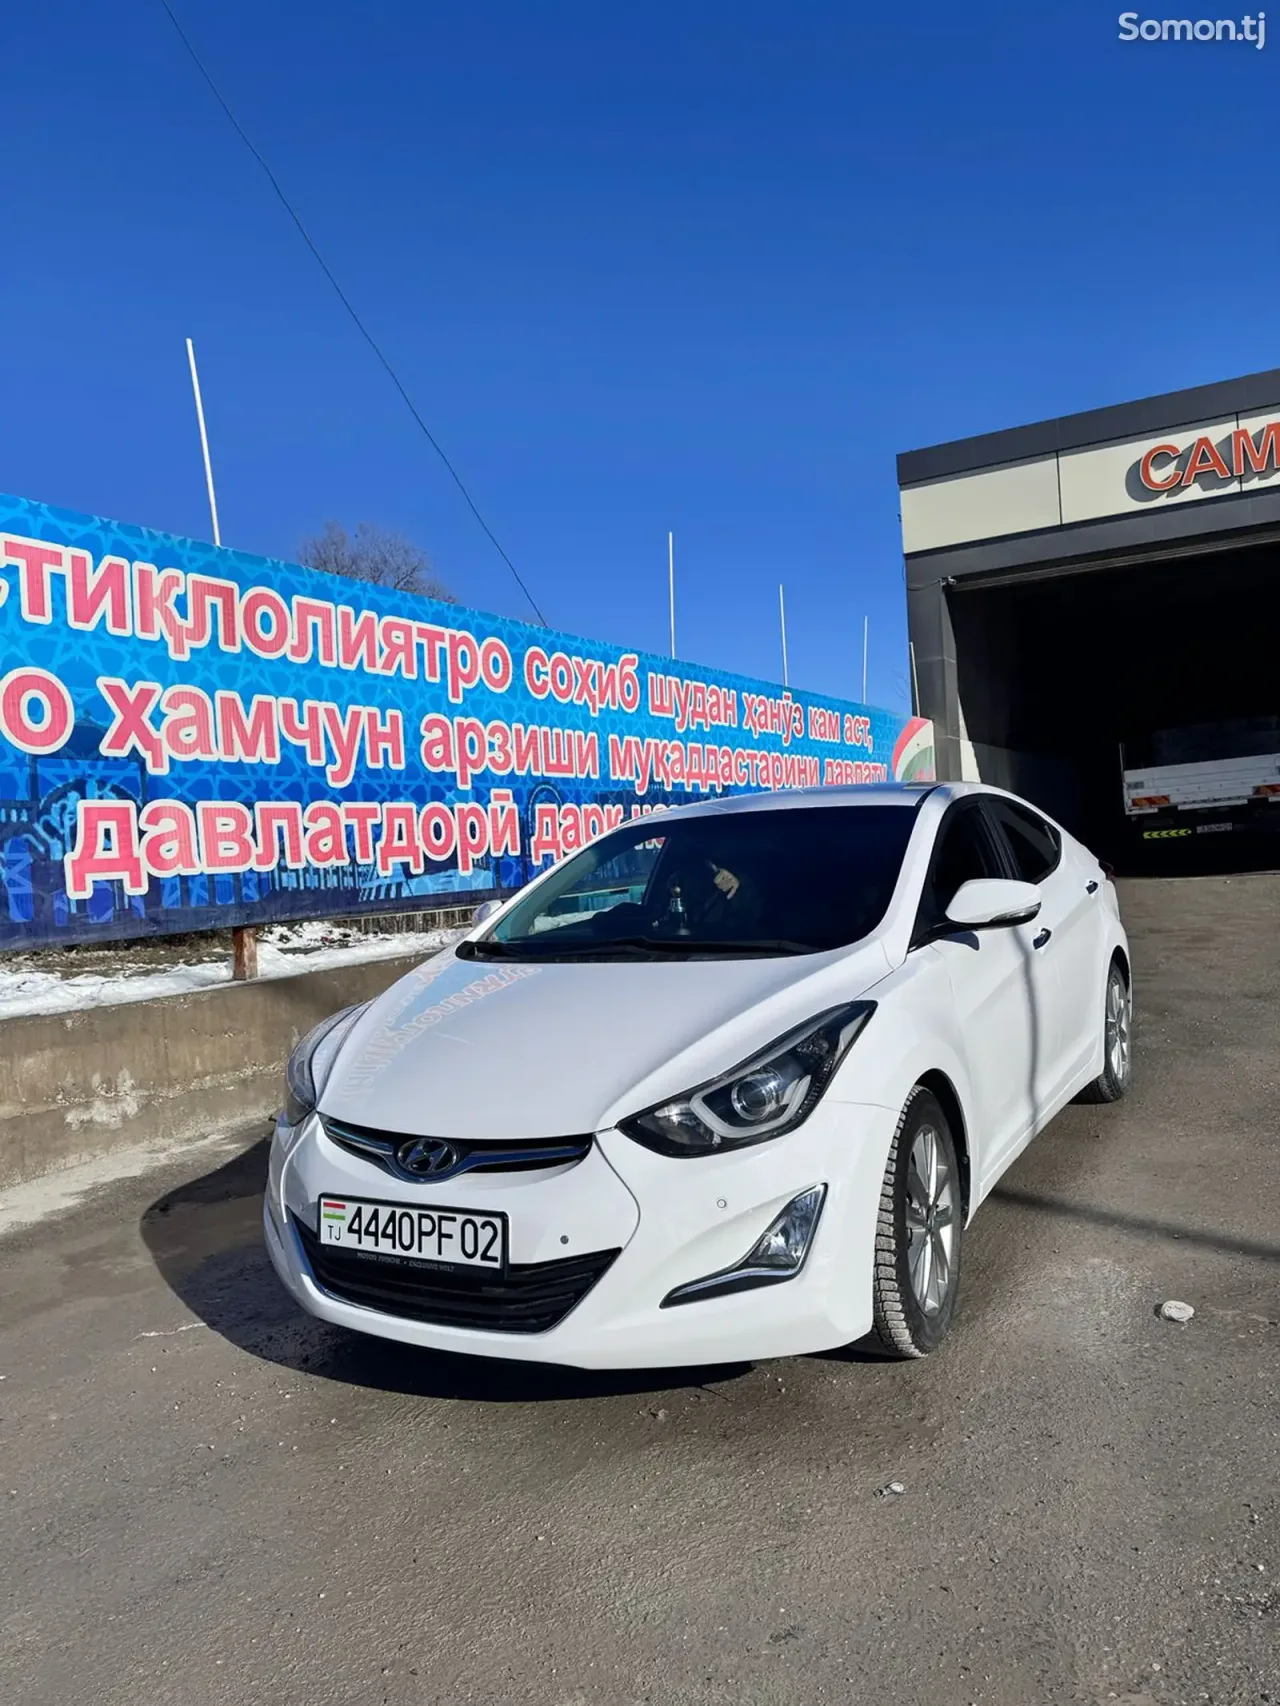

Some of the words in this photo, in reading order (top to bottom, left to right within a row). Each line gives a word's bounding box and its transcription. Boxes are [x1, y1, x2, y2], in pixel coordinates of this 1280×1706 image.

[0, 533, 512, 703] тиқлолиятро
[524, 646, 640, 716] соҳиб
[648, 672, 737, 733] шудан
[808, 705, 841, 742] кам
[844, 713, 873, 753] аст,
[97, 677, 404, 788] ҳамчун
[420, 712, 599, 789] арзиши
[609, 733, 820, 795] муқаддастарини
[64, 788, 521, 899] давлатдорӣ
[327, 1224, 342, 1242] TJ
